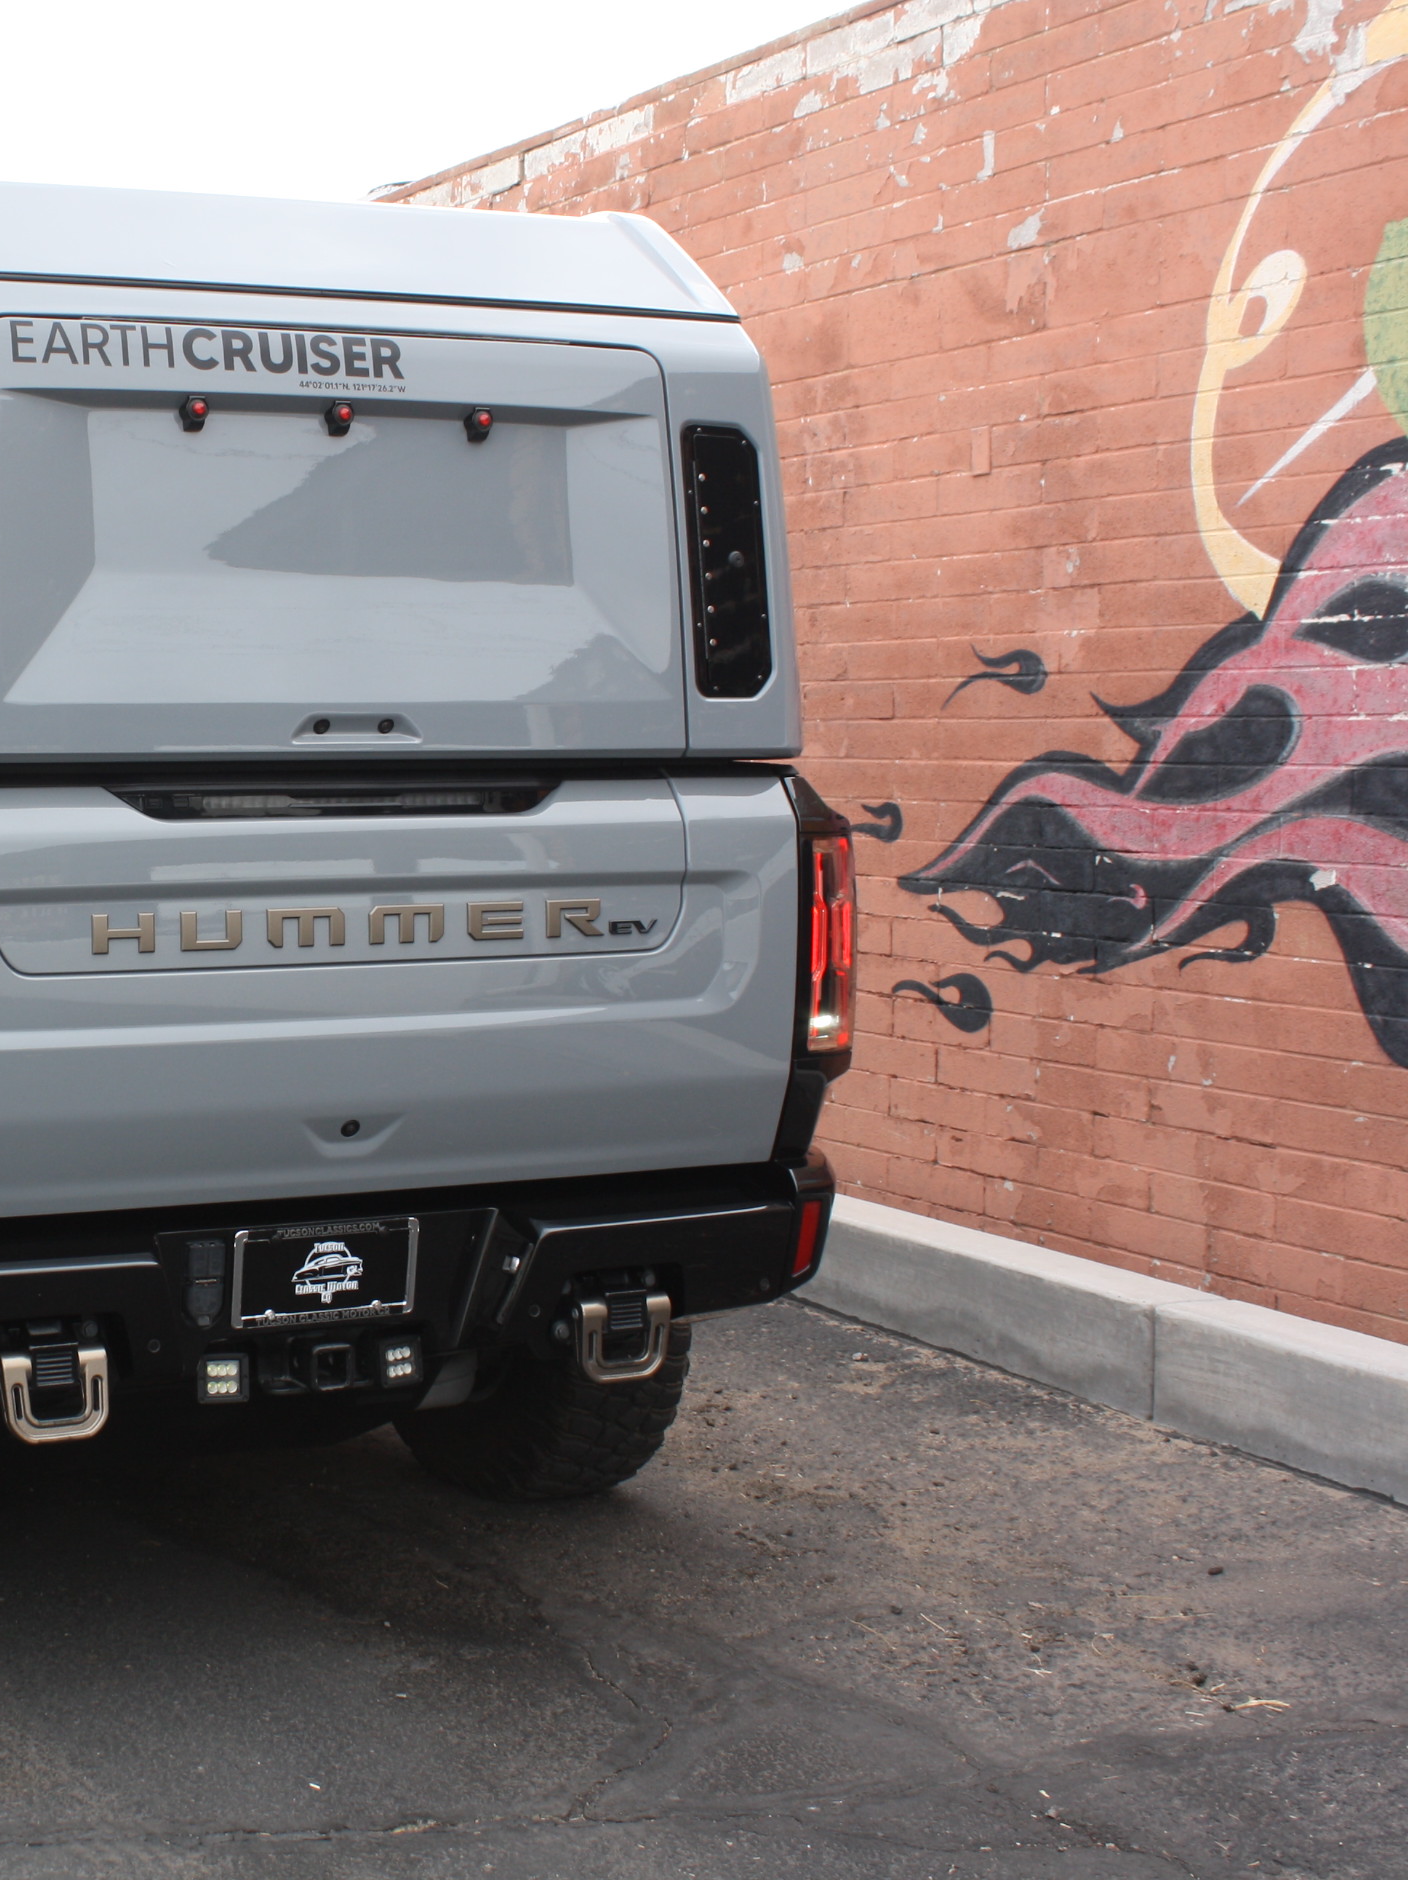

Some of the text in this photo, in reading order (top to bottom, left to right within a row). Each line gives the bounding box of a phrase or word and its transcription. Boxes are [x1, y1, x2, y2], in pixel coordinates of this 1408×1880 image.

[9, 320, 405, 380] EARTHCRUISER
[91, 897, 658, 956] HUMMER EV
[298, 1311, 341, 1324] CLASSIC
[342, 1308, 375, 1320] MOTOR
